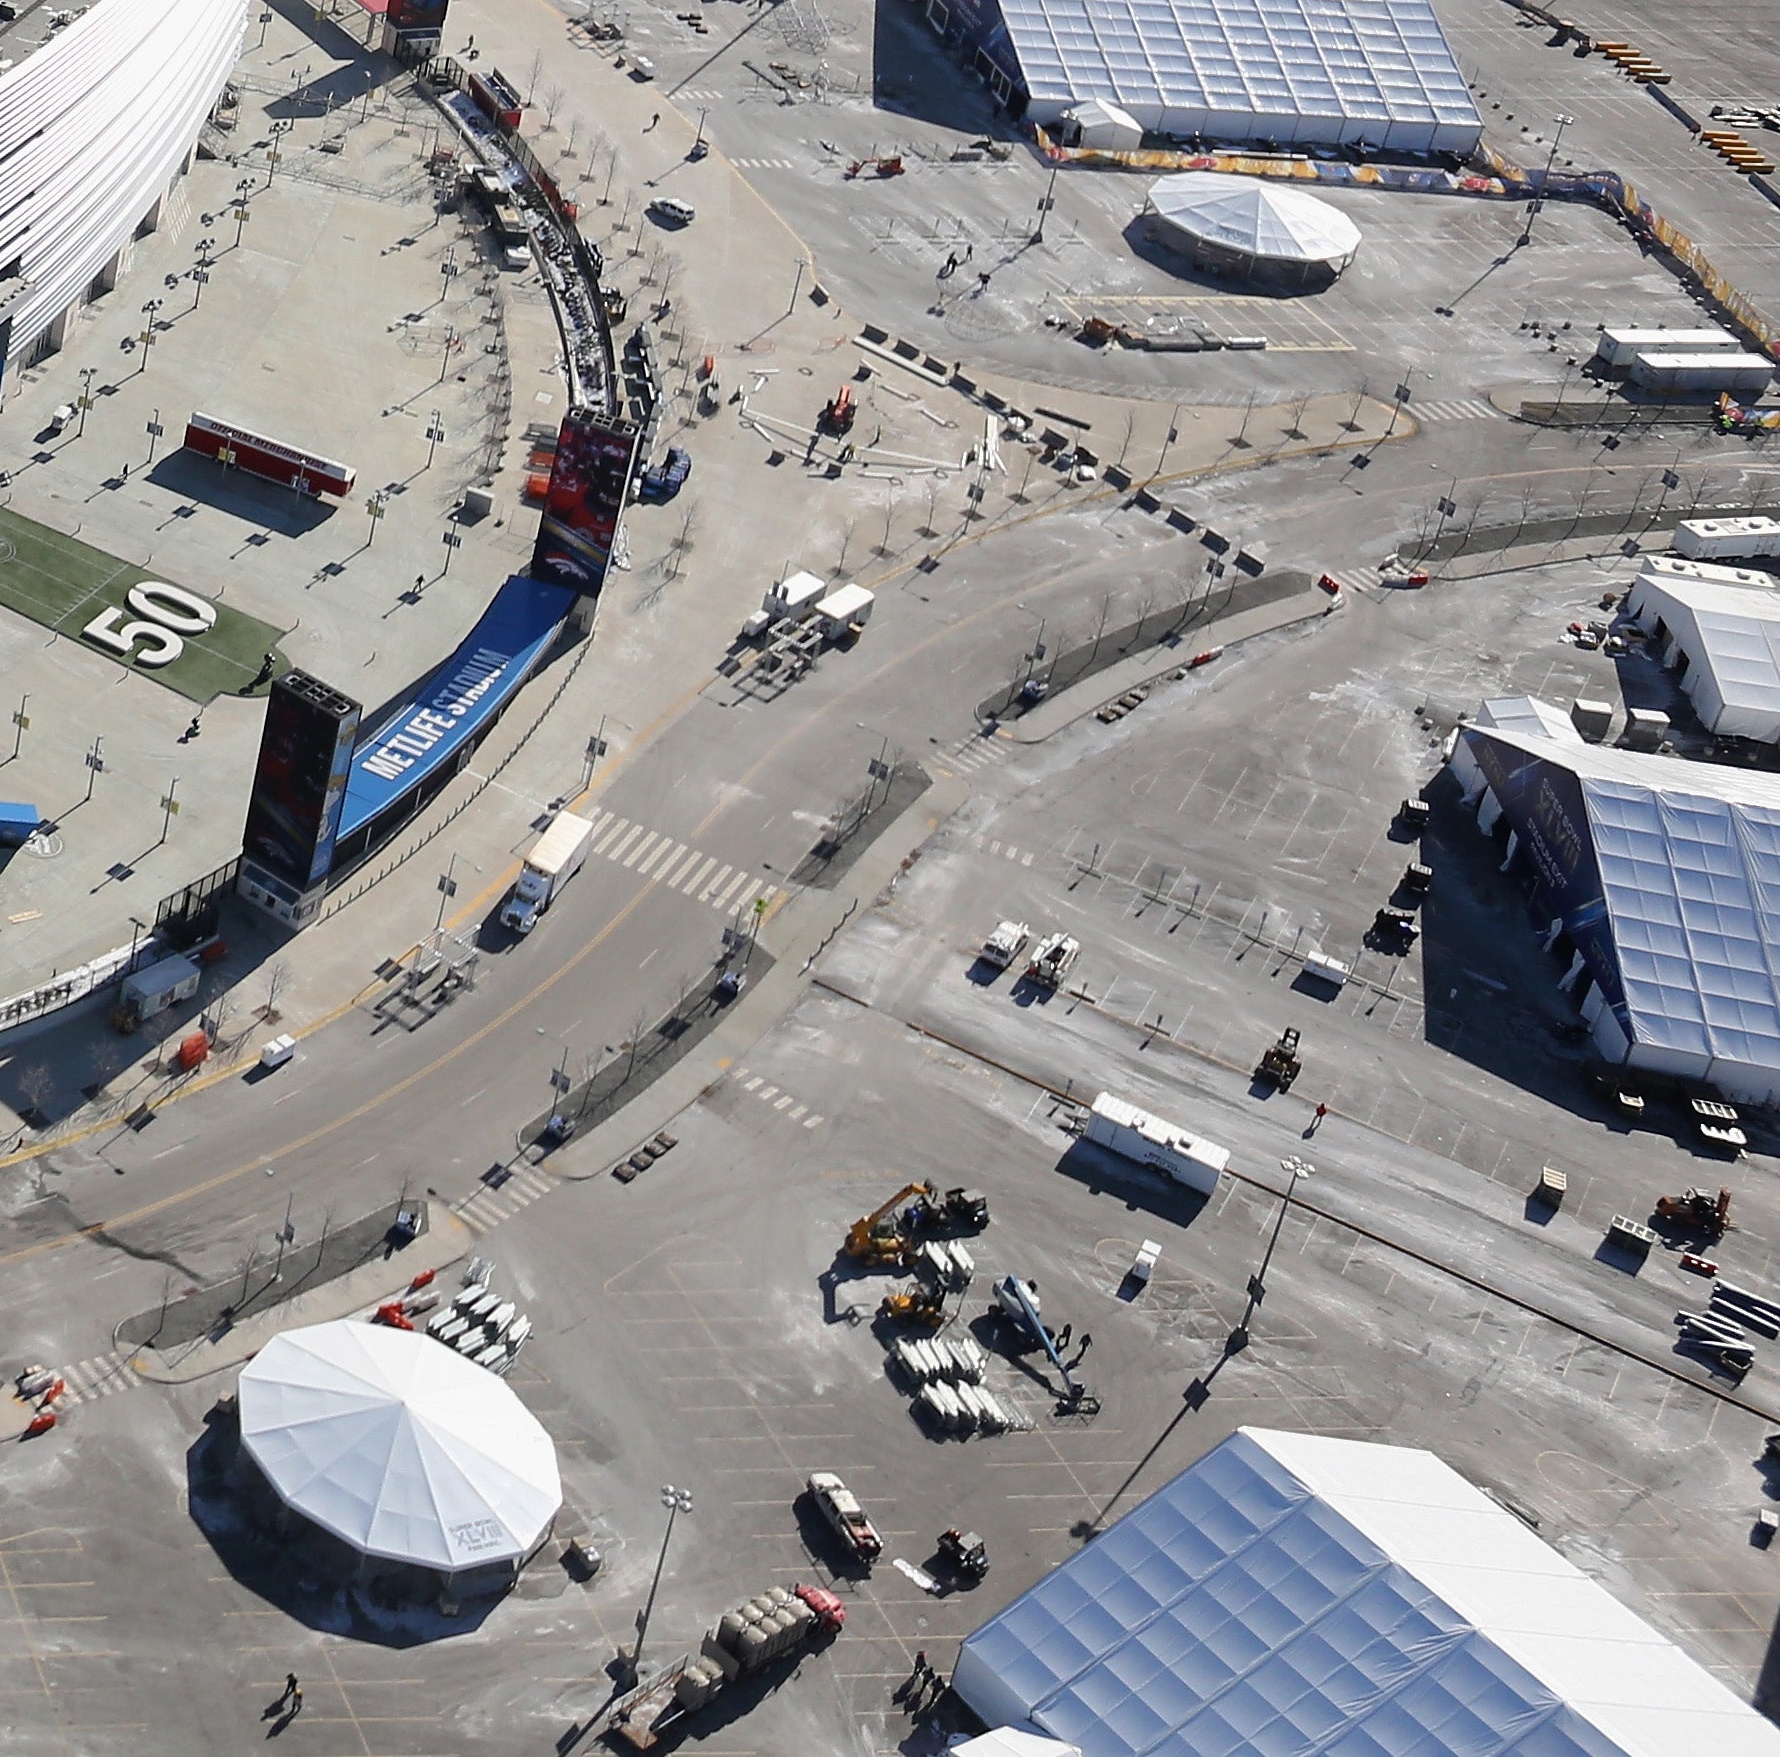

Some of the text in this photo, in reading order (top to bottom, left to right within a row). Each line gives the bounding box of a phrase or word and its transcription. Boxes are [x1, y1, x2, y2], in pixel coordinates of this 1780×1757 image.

[81, 580, 218, 668] 50
[361, 645, 511, 781] METLIFE STADIUM
